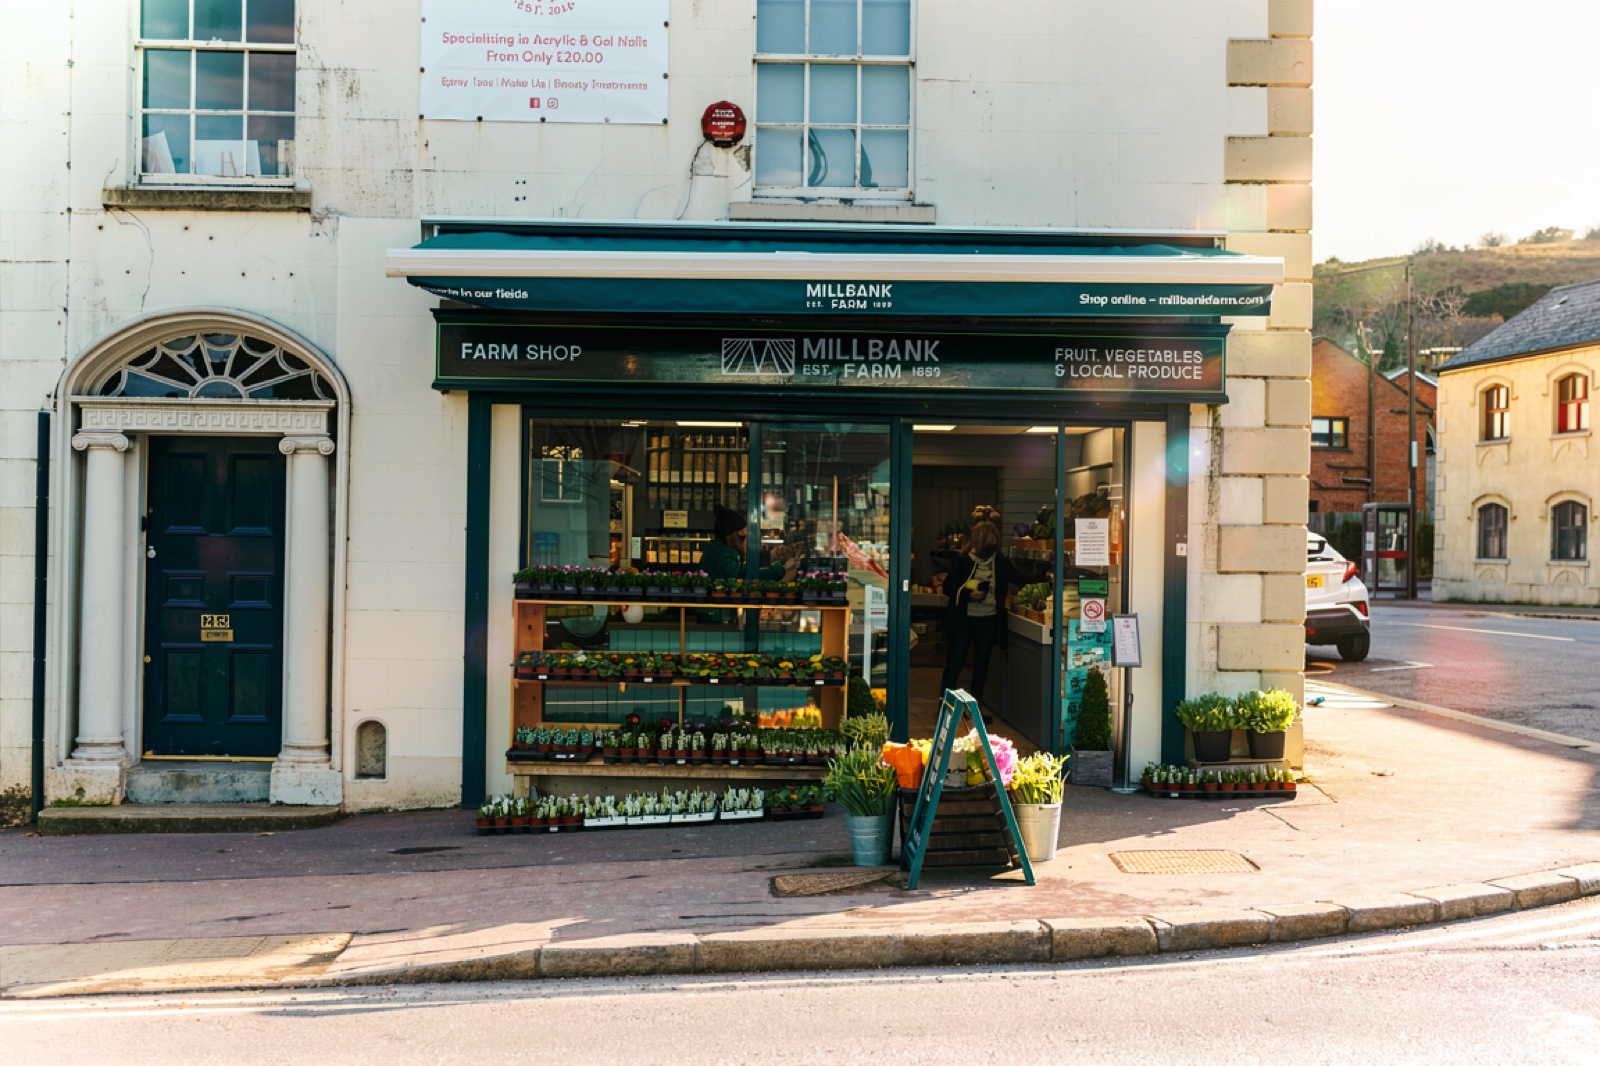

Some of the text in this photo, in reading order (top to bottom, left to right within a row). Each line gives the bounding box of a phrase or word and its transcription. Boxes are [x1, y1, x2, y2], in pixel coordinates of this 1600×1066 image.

[442, 31, 515, 47] Specialising
[518, 33, 530, 45] in
[532, 34, 576, 47] Acrylic
[592, 35, 614, 47] Gel
[617, 36, 648, 48] Nails
[486, 50, 604, 65] From Only £20.00
[441, 76, 469, 88] Spray
[473, 77, 494, 87] Tans
[500, 78, 529, 88] Make
[531, 79, 547, 90] Up
[553, 79, 588, 91] Beauty
[592, 80, 648, 91] Treatments
[460, 288, 472, 298] in
[474, 291, 493, 299] our
[496, 289, 529, 299] fields
[806, 284, 893, 297] MILLBANK
[831, 300, 868, 309] FARM
[1079, 293, 1108, 307] Shop
[1111, 295, 1147, 305] online
[1159, 294, 1264, 306] millbankfarm.com
[461, 342, 582, 361] FARM SHOP
[803, 339, 940, 361] MILLBANK
[1104, 349, 1204, 364] VEGETABLES
[802, 363, 941, 379] EST. FARM 1889
[1054, 363, 1203, 380] & LOCAL PRODUCE
